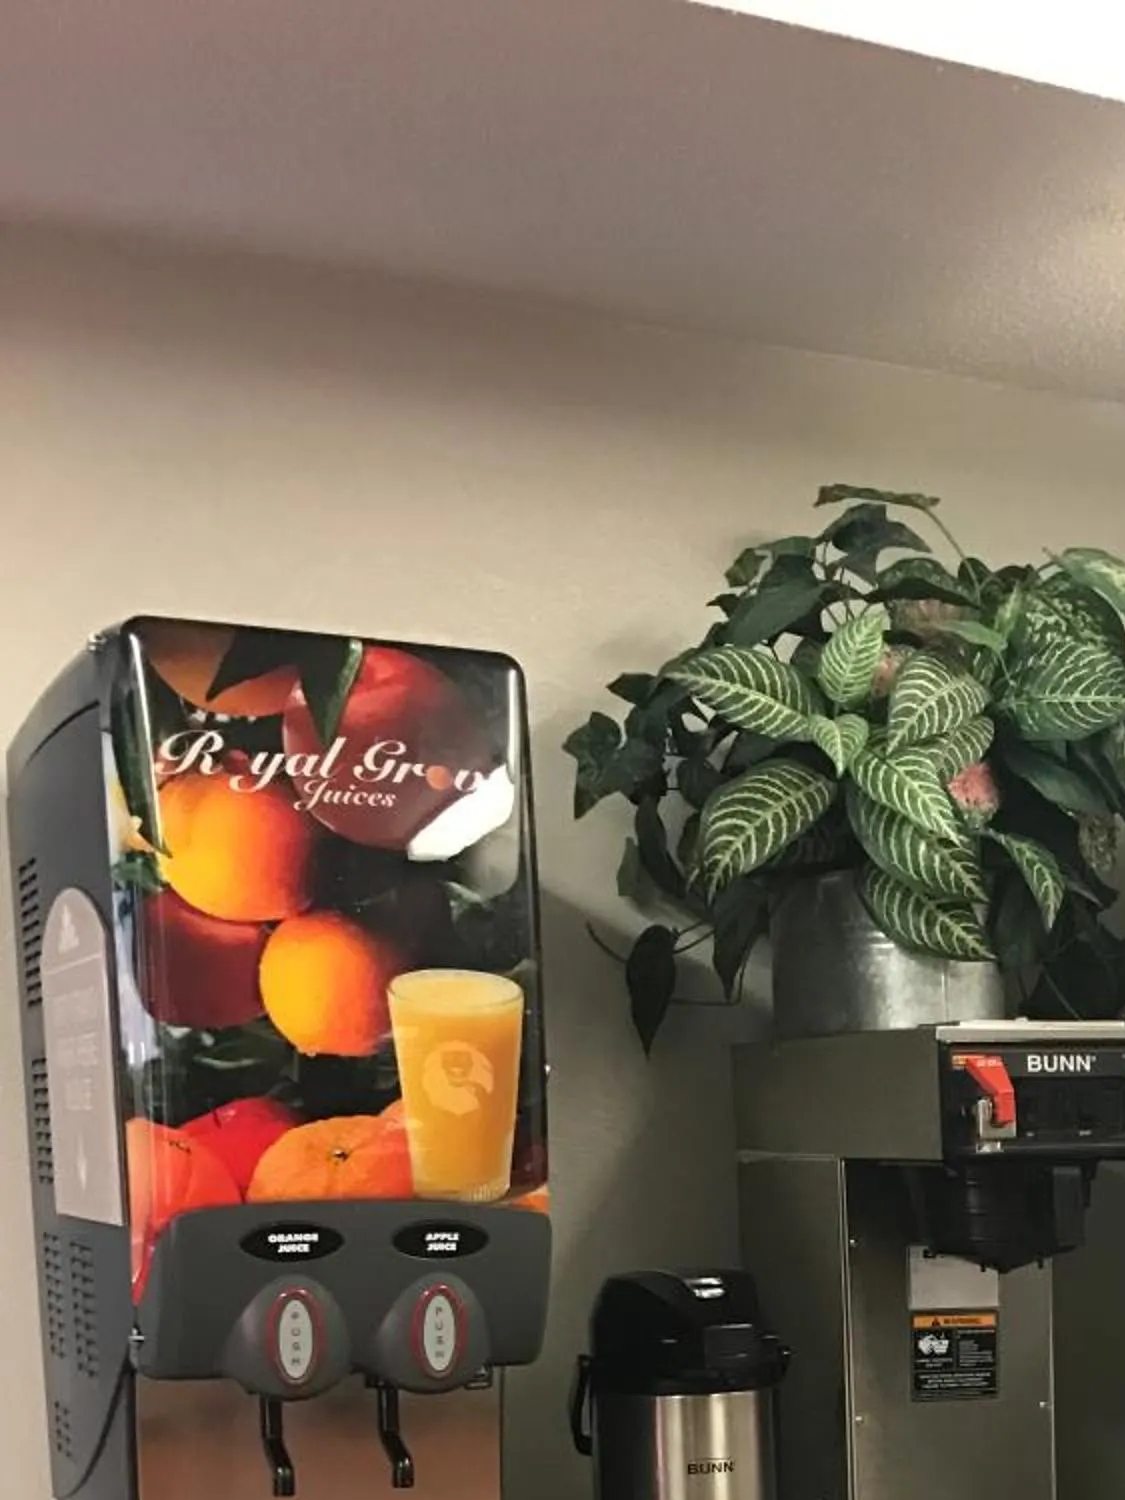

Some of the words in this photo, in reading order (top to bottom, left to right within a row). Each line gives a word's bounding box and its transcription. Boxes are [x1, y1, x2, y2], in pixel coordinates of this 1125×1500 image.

[353, 740, 500, 793] Grov
[293, 777, 397, 812] Juices
[1026, 1054, 1092, 1073] BUNN
[424, 1232, 460, 1243] APPLE
[277, 1244, 310, 1253] JUICE
[426, 1242, 458, 1252] JUICE
[687, 1461, 734, 1475] BUNN
